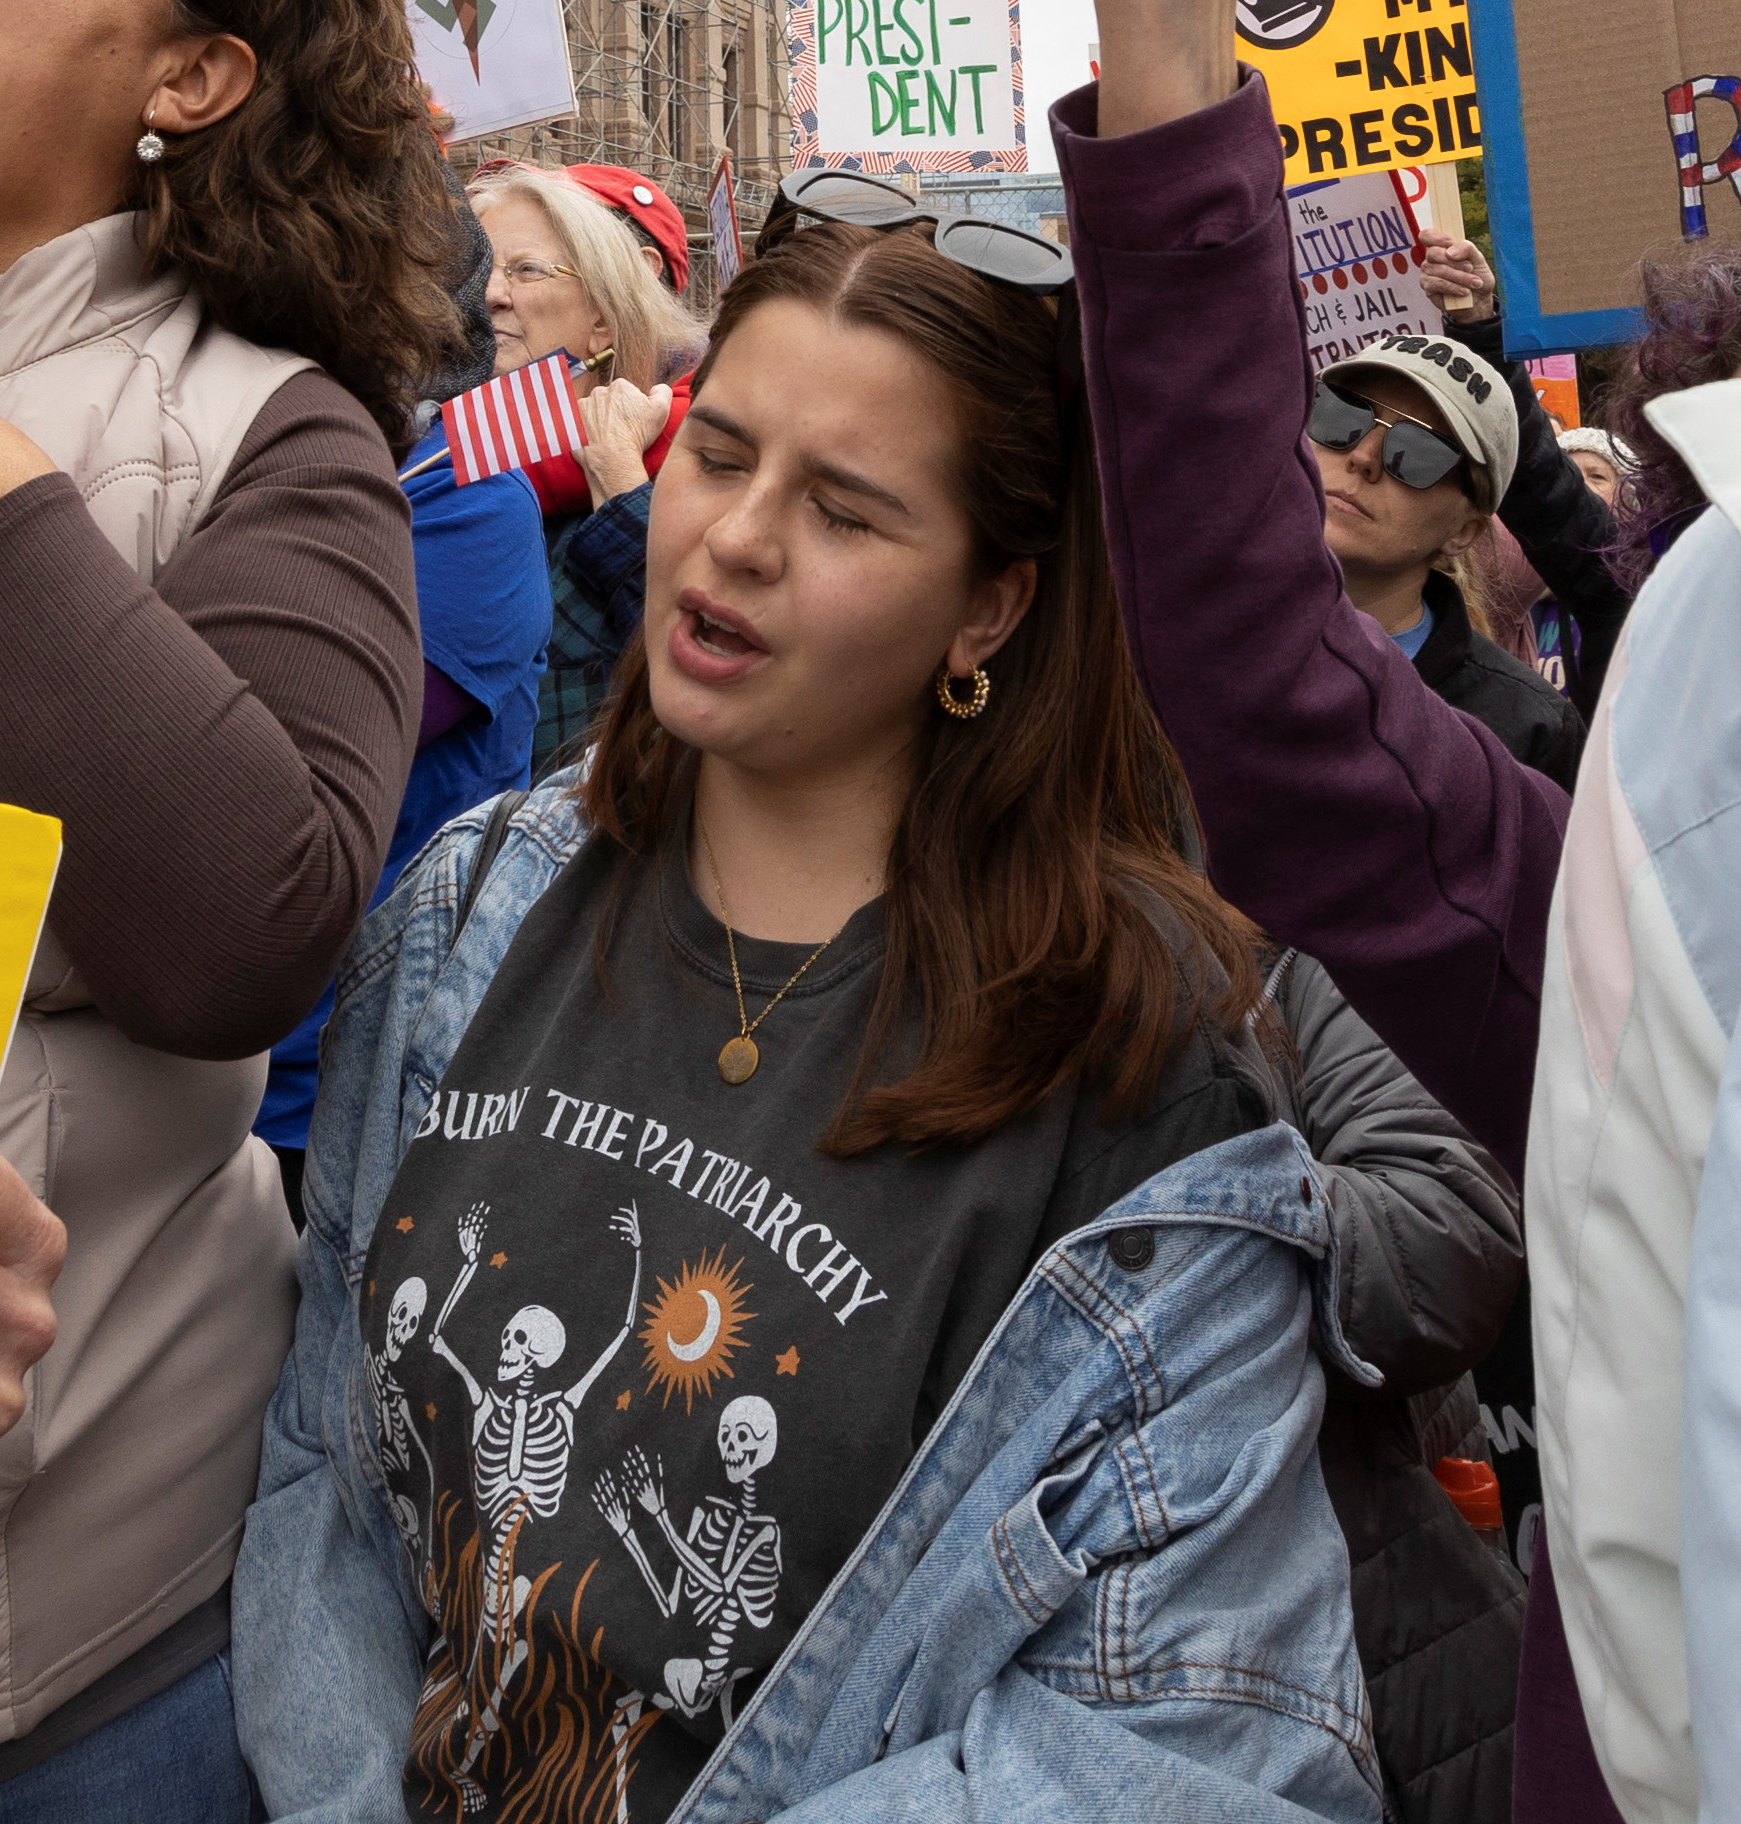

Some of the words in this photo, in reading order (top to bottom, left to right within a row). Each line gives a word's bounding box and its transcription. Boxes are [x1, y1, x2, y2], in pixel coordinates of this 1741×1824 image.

[866, 63, 998, 137] DENT
[1298, 199, 1328, 225] the
[1334, 298, 1347, 325] &
[1354, 288, 1408, 322] JAIL
[1380, 335, 1492, 404] TRASH
[415, 1086, 531, 1141] BURN
[541, 1088, 635, 1161] THE
[634, 1118, 888, 1326] PATRIARCHY
